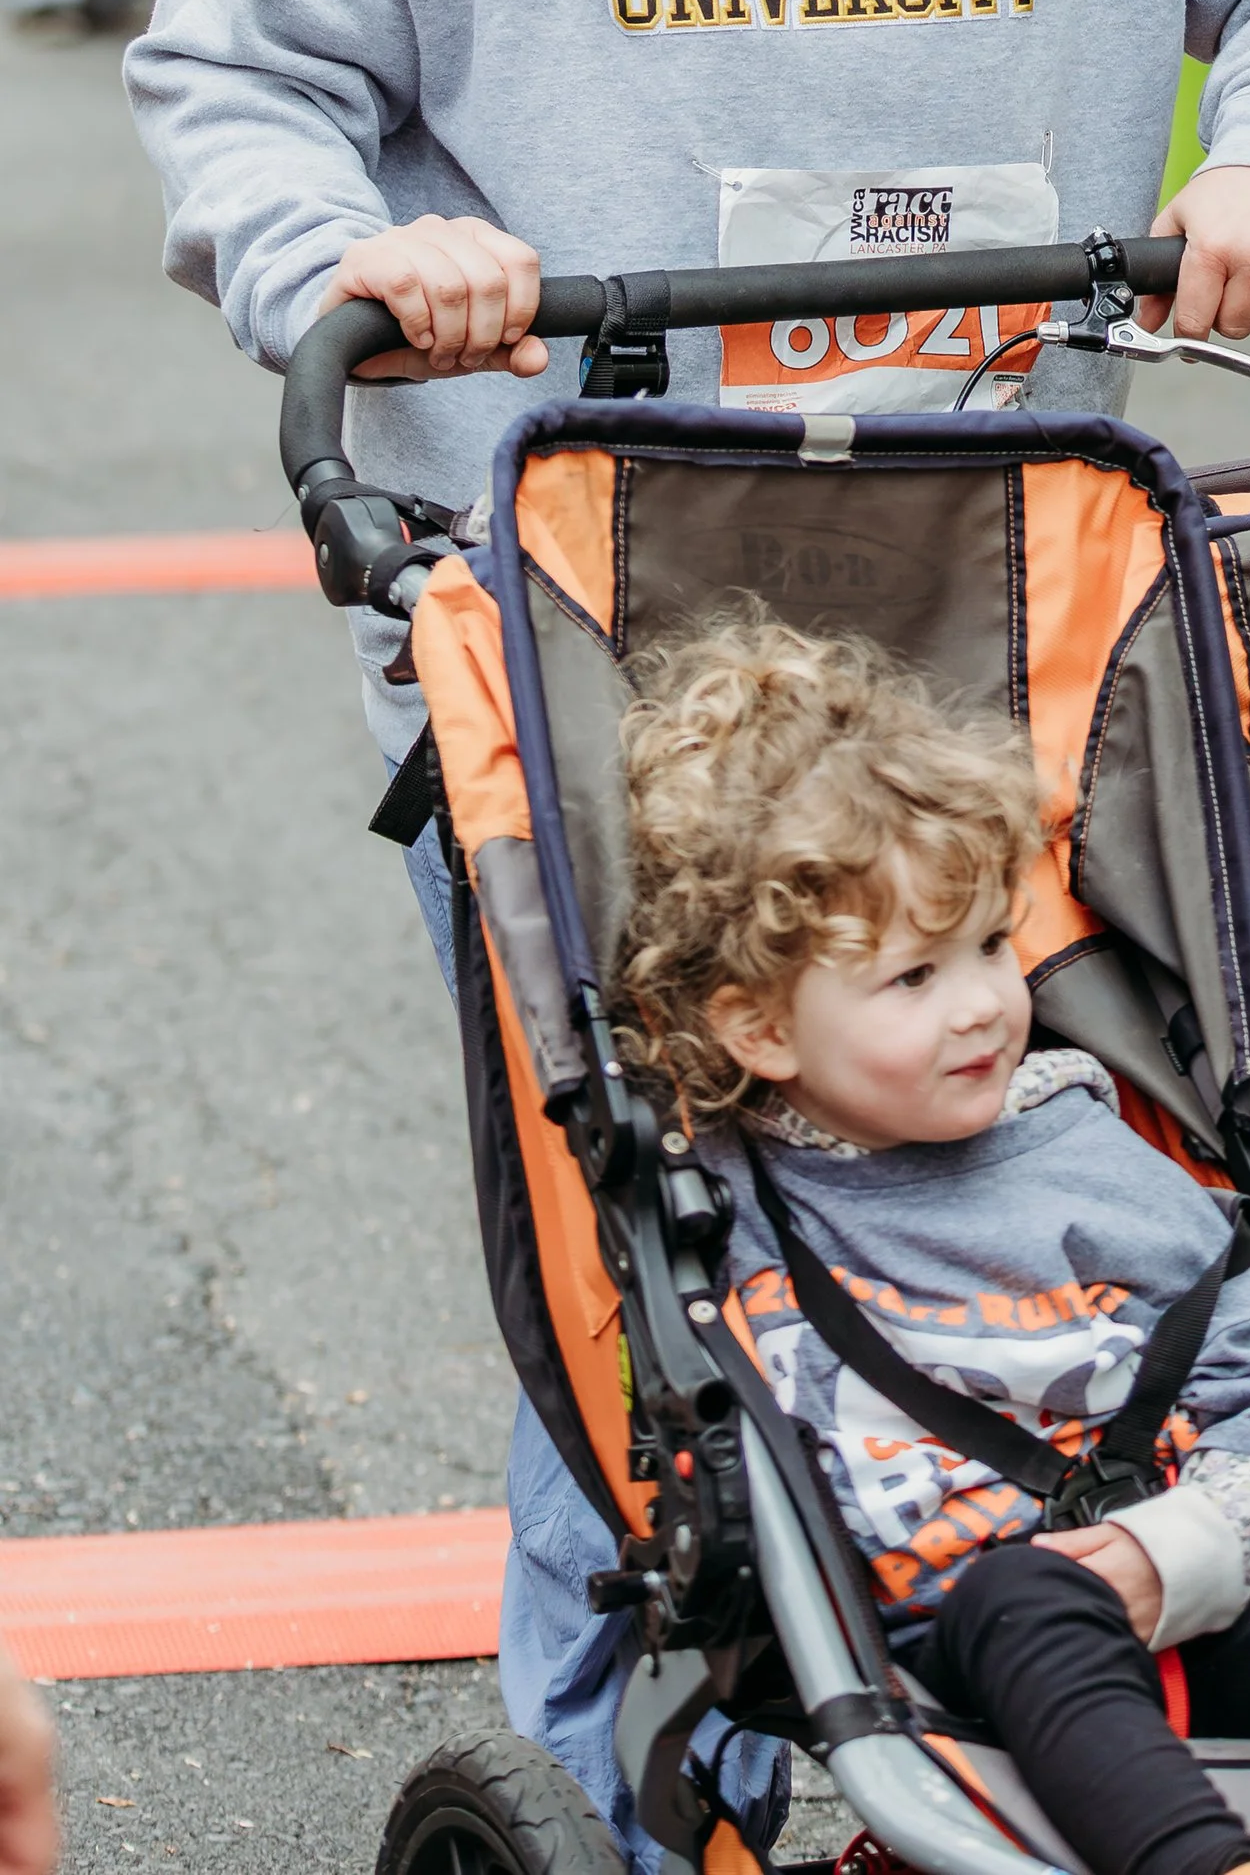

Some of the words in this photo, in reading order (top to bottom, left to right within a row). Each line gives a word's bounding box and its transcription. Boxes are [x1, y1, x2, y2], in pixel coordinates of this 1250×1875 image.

[850, 188, 866, 241] ywca
[869, 191, 953, 215] race
[868, 208, 948, 230] against
[866, 226, 950, 242] RACISM
[850, 243, 927, 254] LANCASTER,
[932, 243, 947, 253] PA
[869, 1483, 1021, 1602] PRIL
